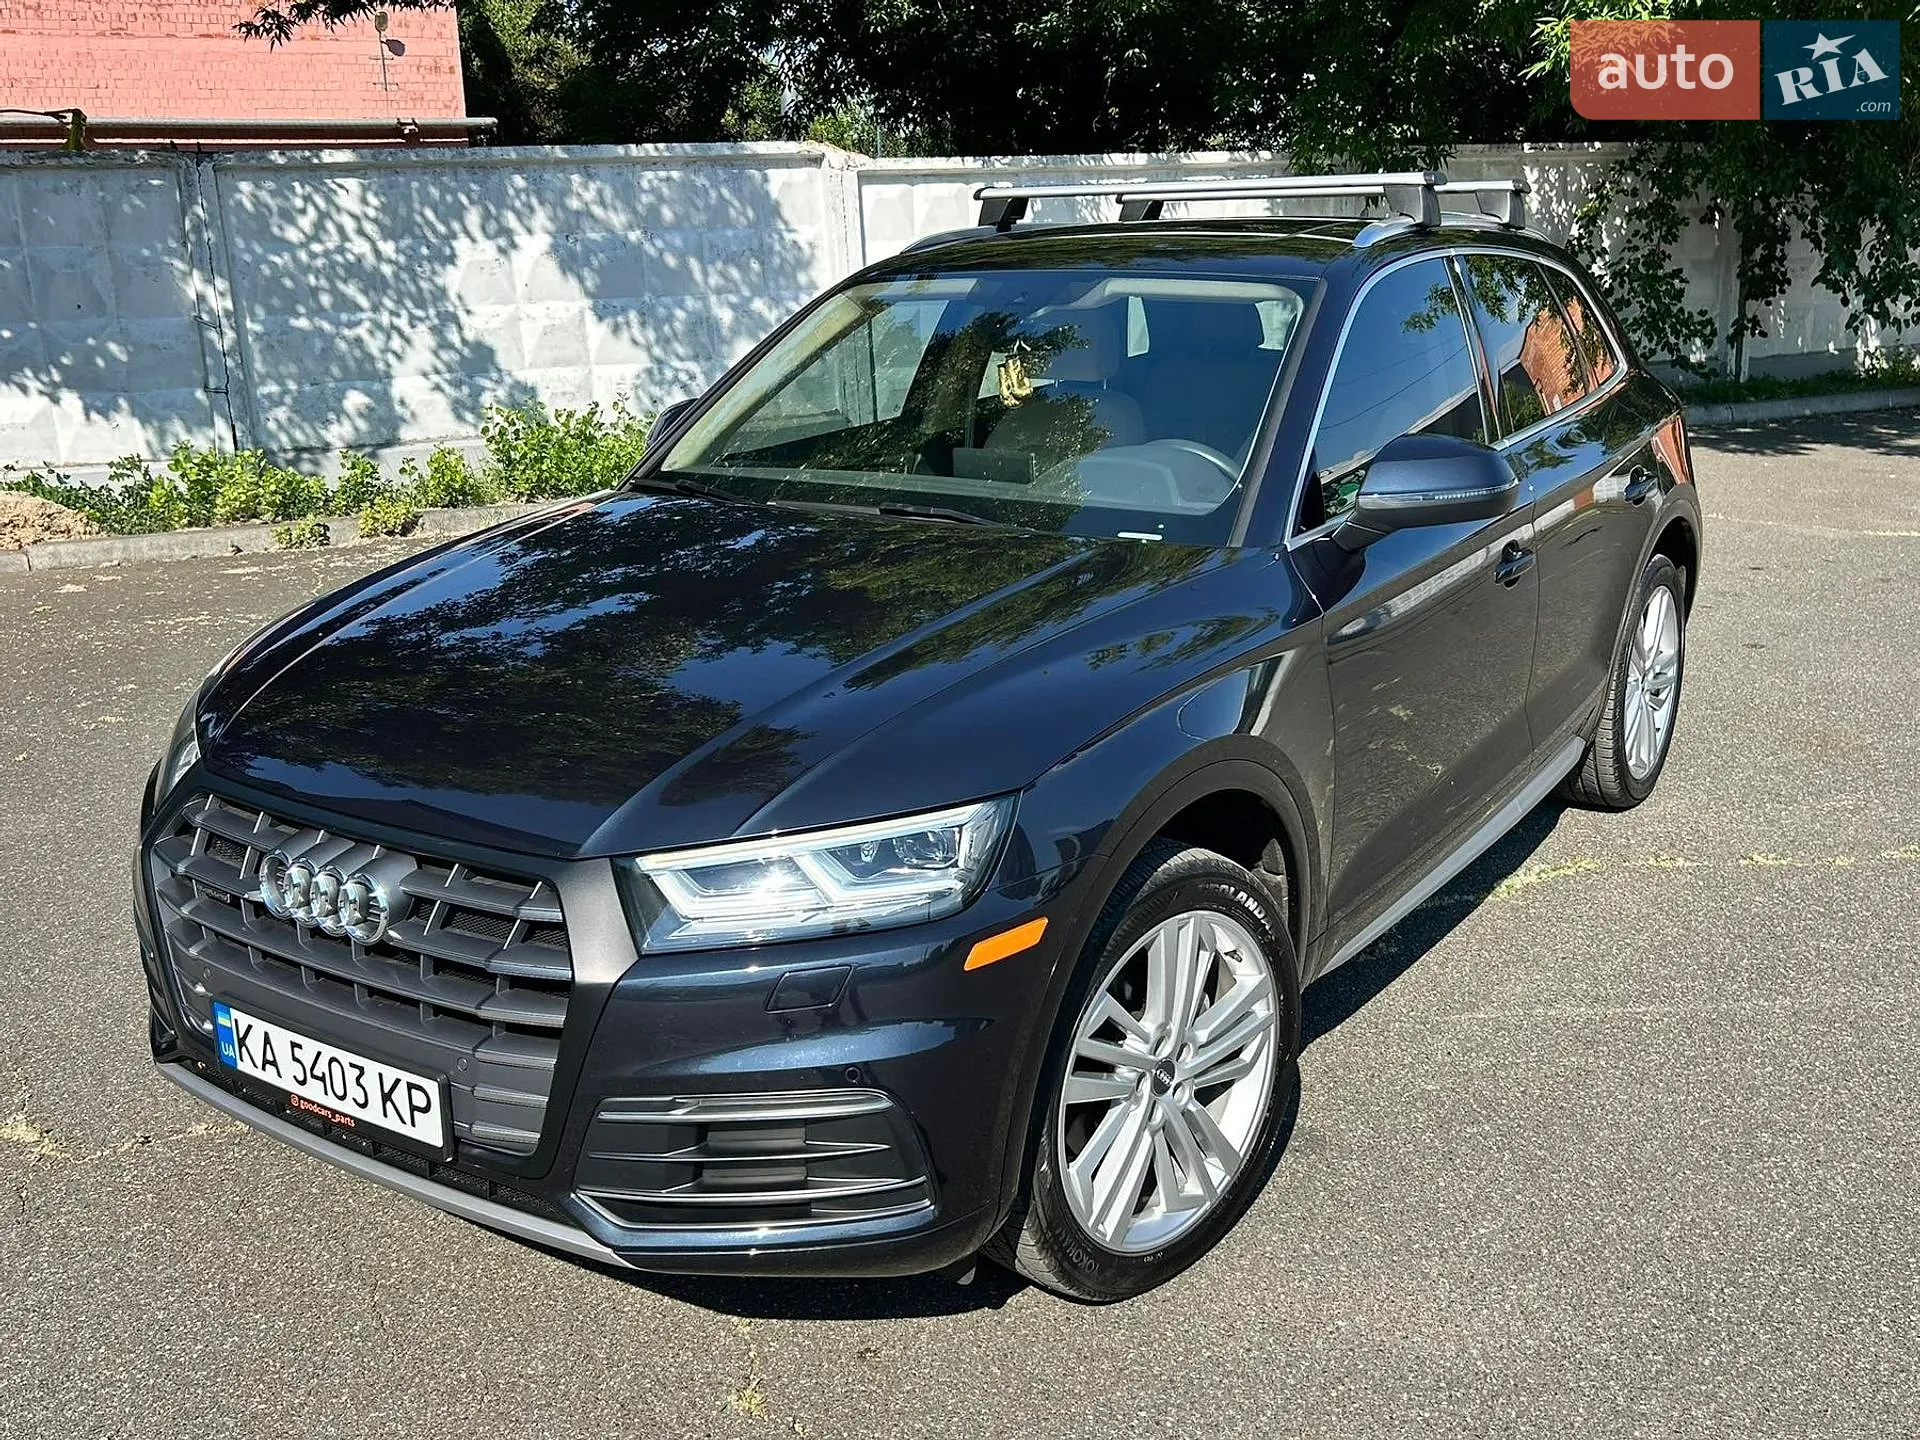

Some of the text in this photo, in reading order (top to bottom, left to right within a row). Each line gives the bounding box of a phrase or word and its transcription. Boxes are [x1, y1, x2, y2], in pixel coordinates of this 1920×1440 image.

[221, 1041, 236, 1059] UA
[234, 1018, 432, 1128] KA 5403 KP
[299, 1098, 356, 1128] goodcars_parts
